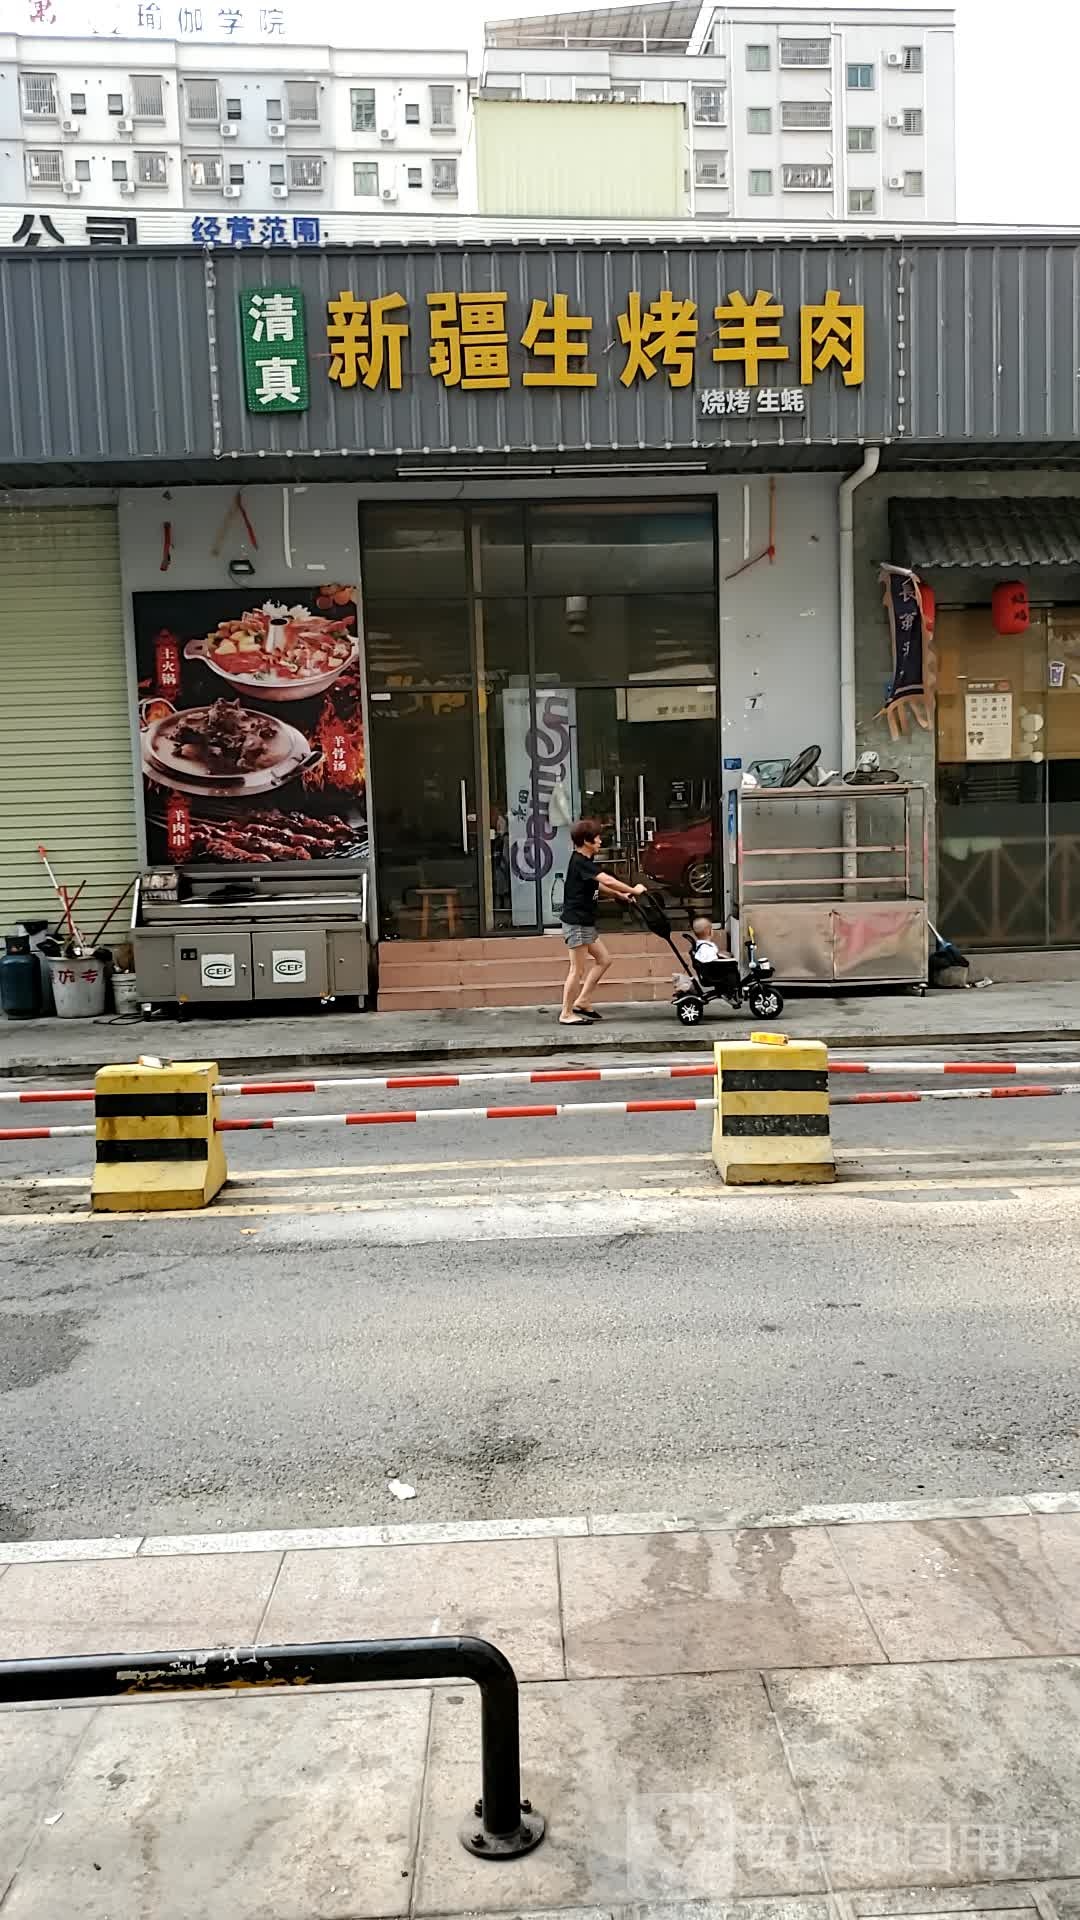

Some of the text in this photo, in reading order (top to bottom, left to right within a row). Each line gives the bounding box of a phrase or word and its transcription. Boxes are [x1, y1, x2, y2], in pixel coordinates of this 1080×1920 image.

[192, 216, 320, 246] 经营范围
[248, 293, 301, 405] 清真
[326, 290, 865, 390] 新疆生烤羊肉
[701, 388, 805, 415] 烧烤 生蚝
[161, 648, 177, 686] 土火锅
[331, 735, 347, 771] 羊骨汤
[172, 810, 186, 847] 羊肉串
